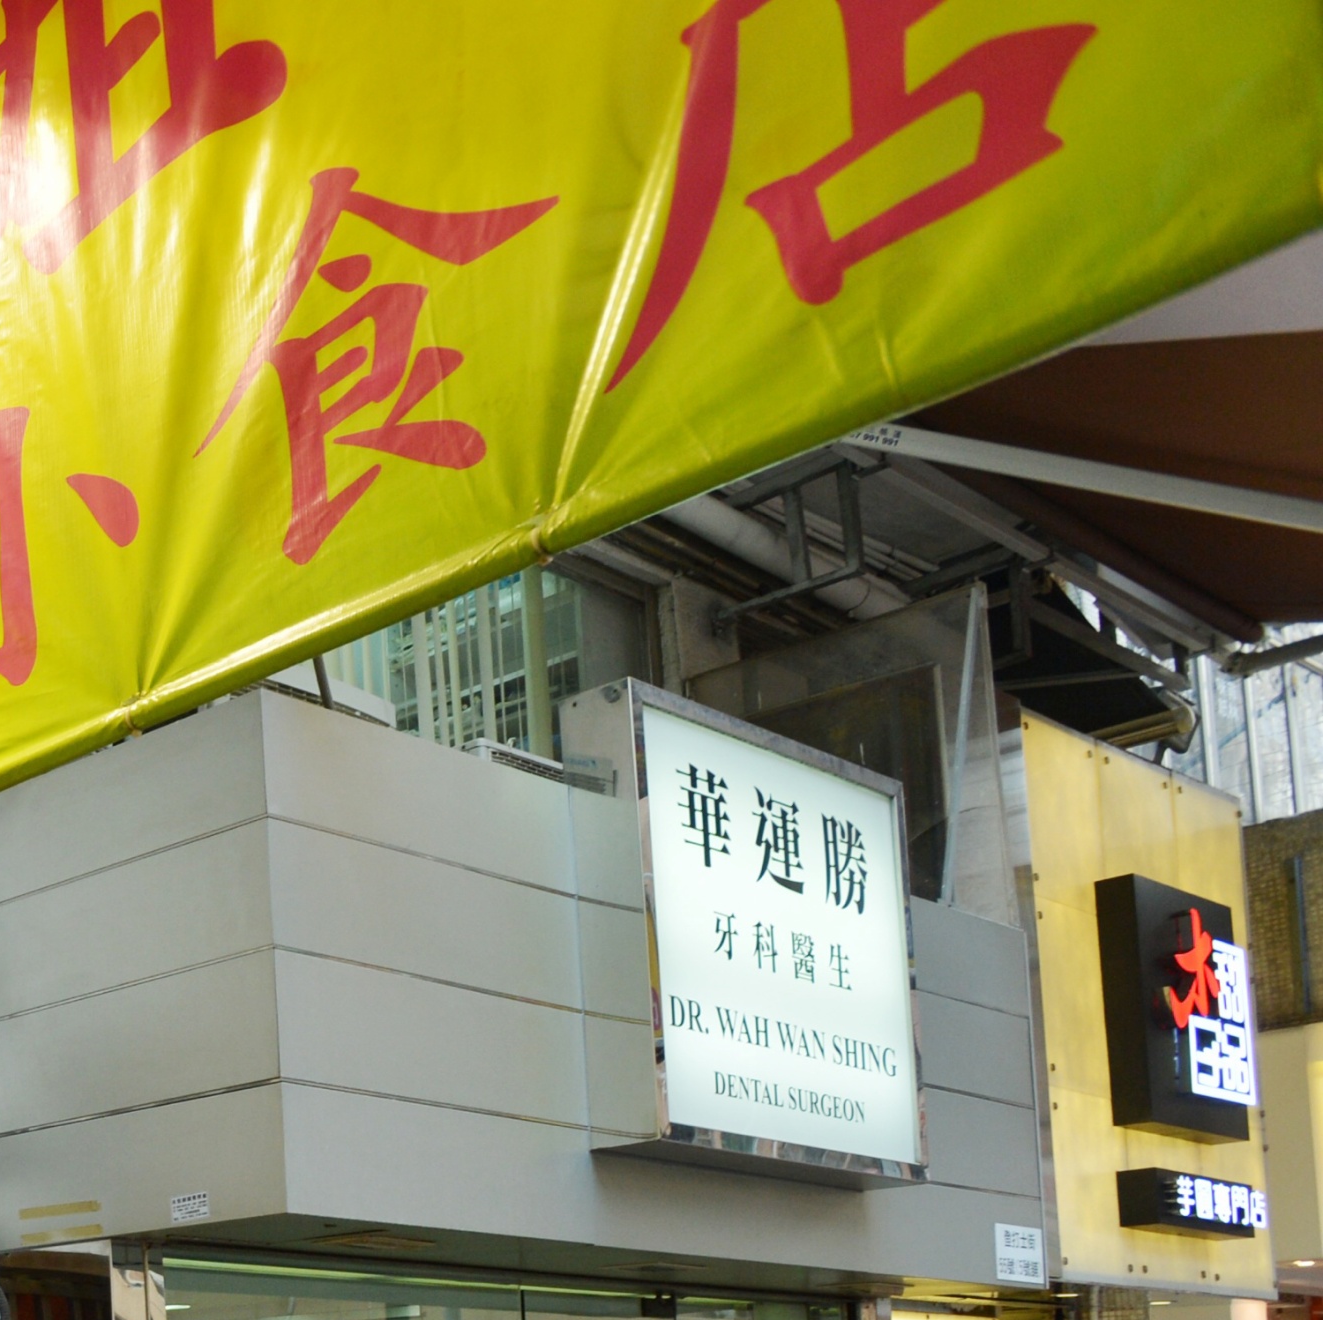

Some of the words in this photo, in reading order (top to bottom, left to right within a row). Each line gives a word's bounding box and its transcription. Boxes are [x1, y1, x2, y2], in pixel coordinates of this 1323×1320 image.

[675, 763, 868, 915] 華運勝
[712, 911, 853, 991] 牙科醫生
[668, 993, 710, 1037] DR.
[716, 1005, 772, 1050] WAH
[776, 1017, 827, 1061] WAN
[831, 1029, 897, 1078] SHING
[714, 1070, 785, 1109] DENTAL
[787, 1081, 867, 1124] SURGEON
